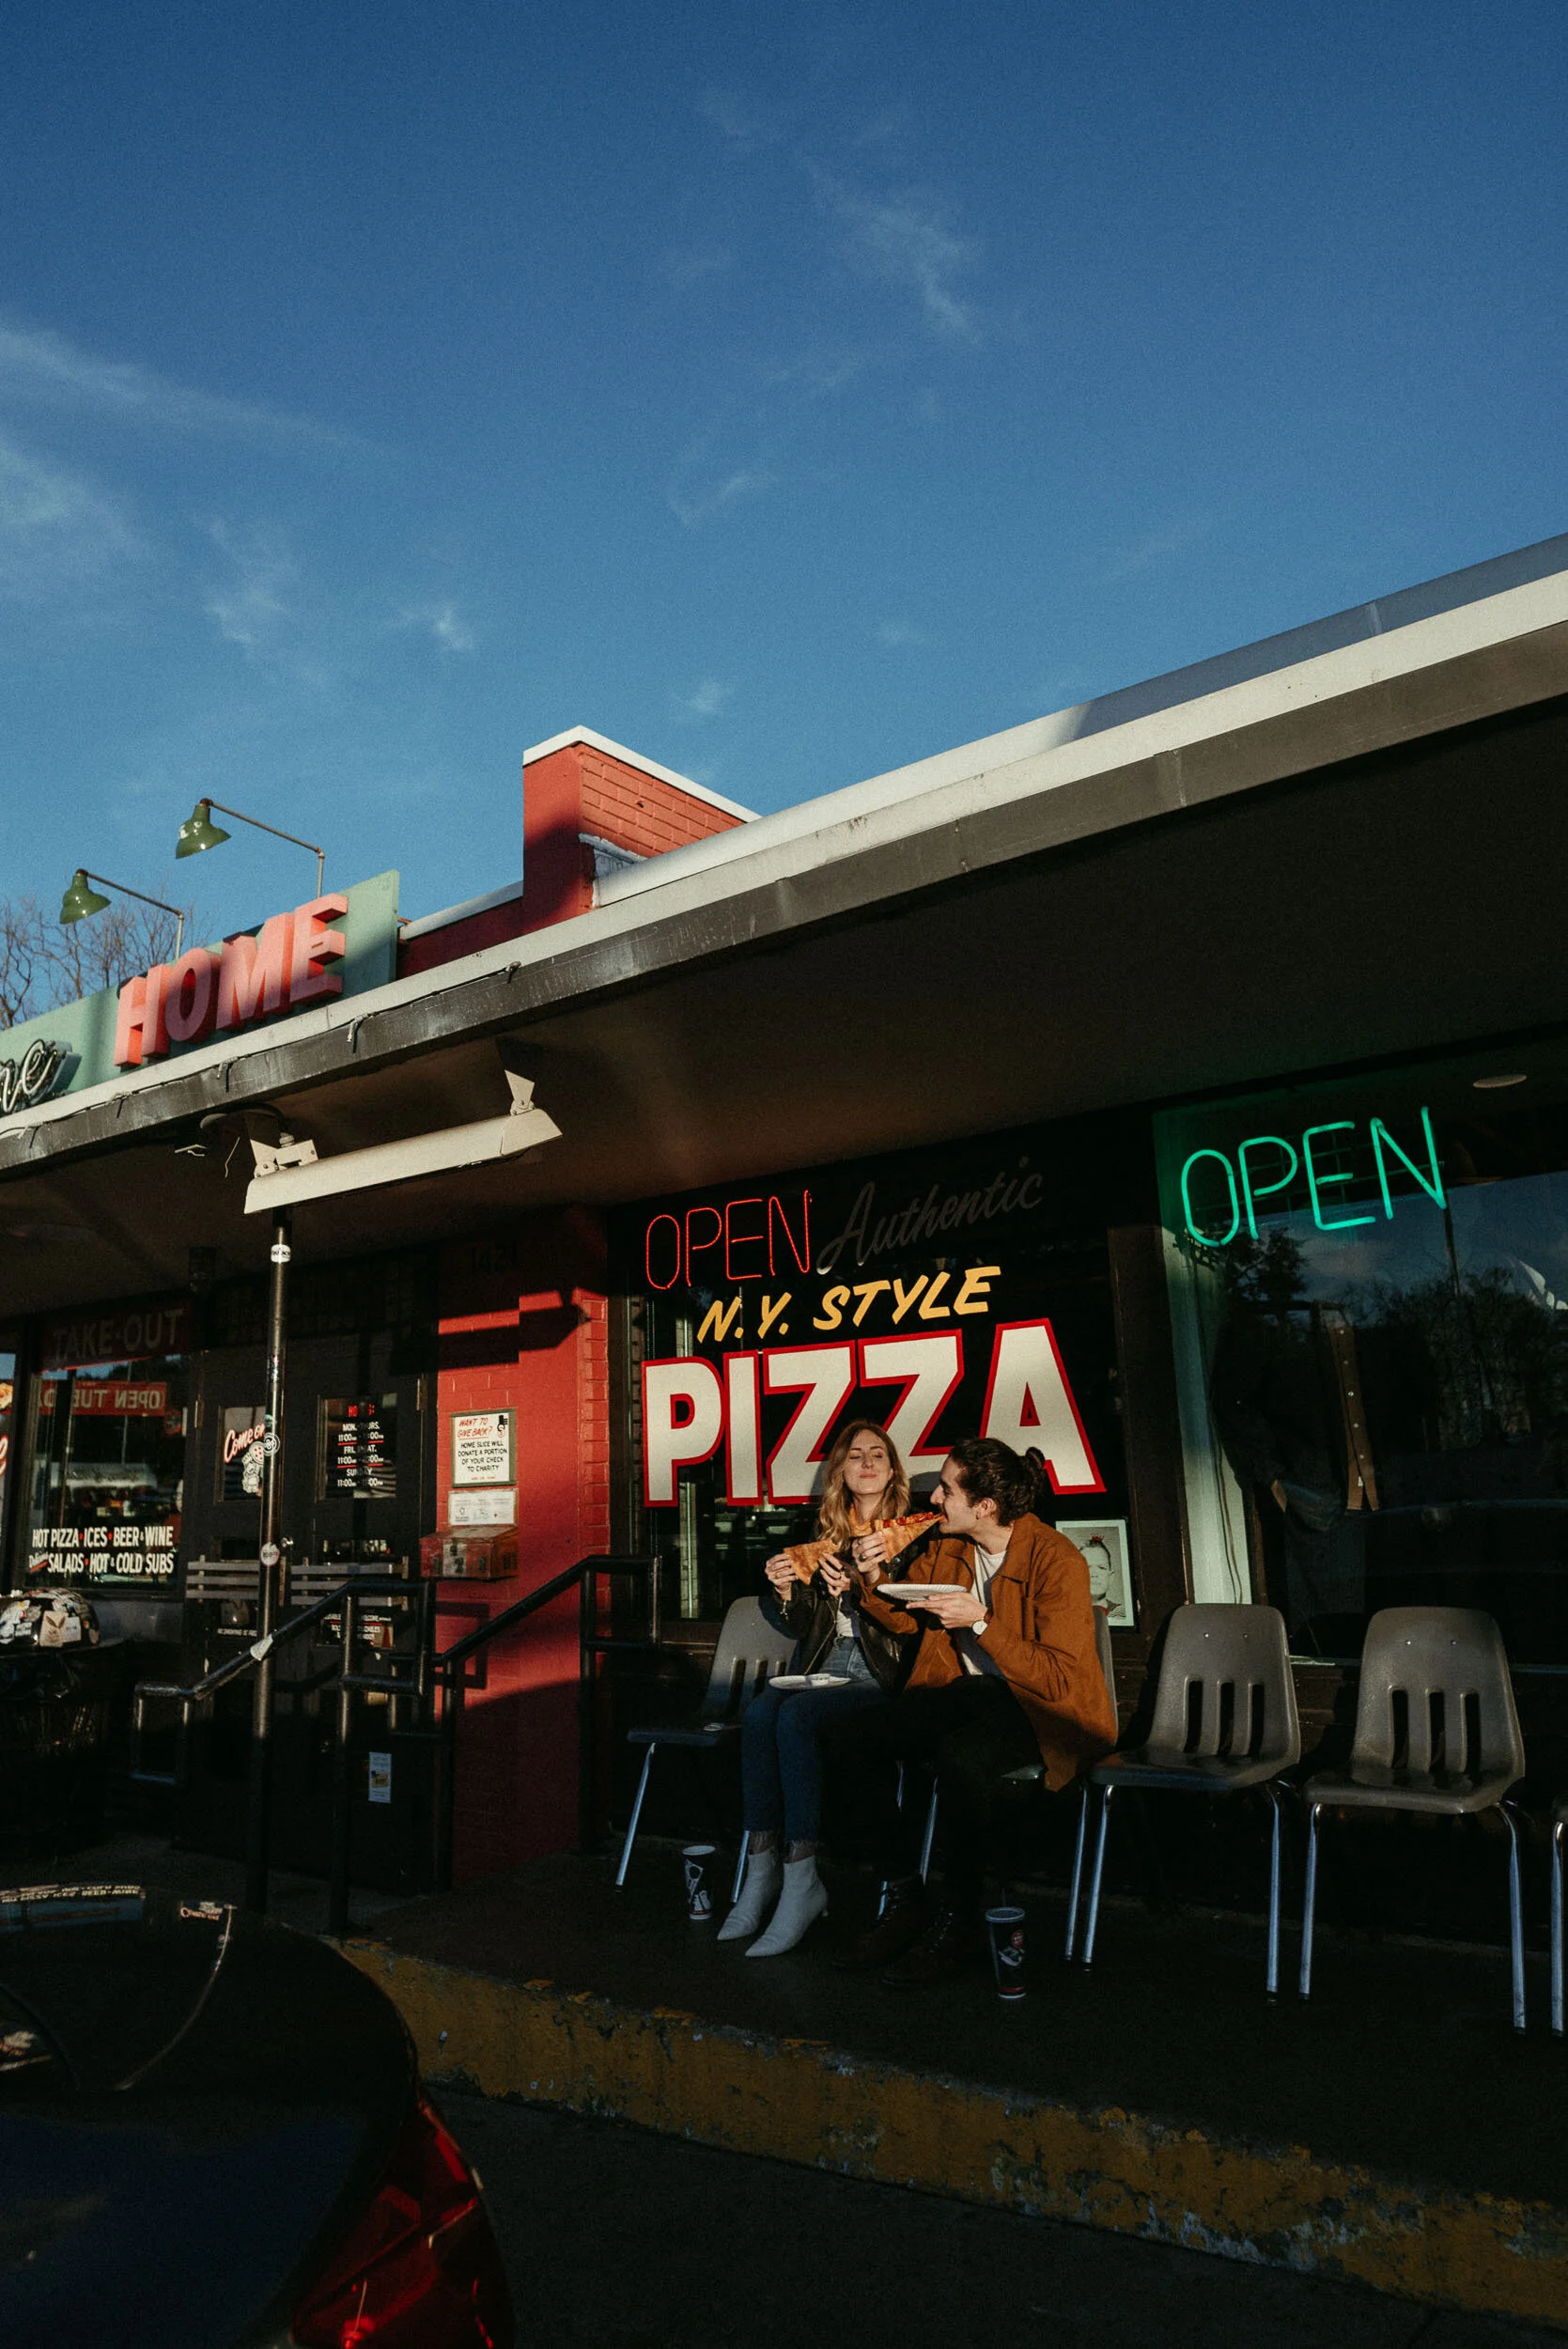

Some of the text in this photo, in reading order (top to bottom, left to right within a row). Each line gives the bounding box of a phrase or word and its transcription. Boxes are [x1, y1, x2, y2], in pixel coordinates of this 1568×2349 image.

[114, 893, 349, 1069] HOME
[815, 1155, 1044, 1276] Authentic
[1180, 1105, 1448, 1247] OPEN
[645, 1189, 813, 1291] OPEN
[696, 1265, 1002, 1345] N.Y. STYLE
[458, 1428, 472, 1438] GIVE
[459, 1417, 489, 1427] WANT TO
[643, 1317, 1108, 1507] PIZZA
[458, 1449, 477, 1457] DONATE
[32, 1528, 50, 1548] HOT
[51, 1527, 80, 1548] PIZZA
[84, 1525, 108, 1548] ICES
[113, 1526, 139, 1548] BEER
[144, 1526, 174, 1547] WINE
[48, 1552, 85, 1573] SALADS
[89, 1552, 111, 1574] HOT
[116, 1552, 144, 1574] COLD
[145, 1552, 174, 1574] SUBS
